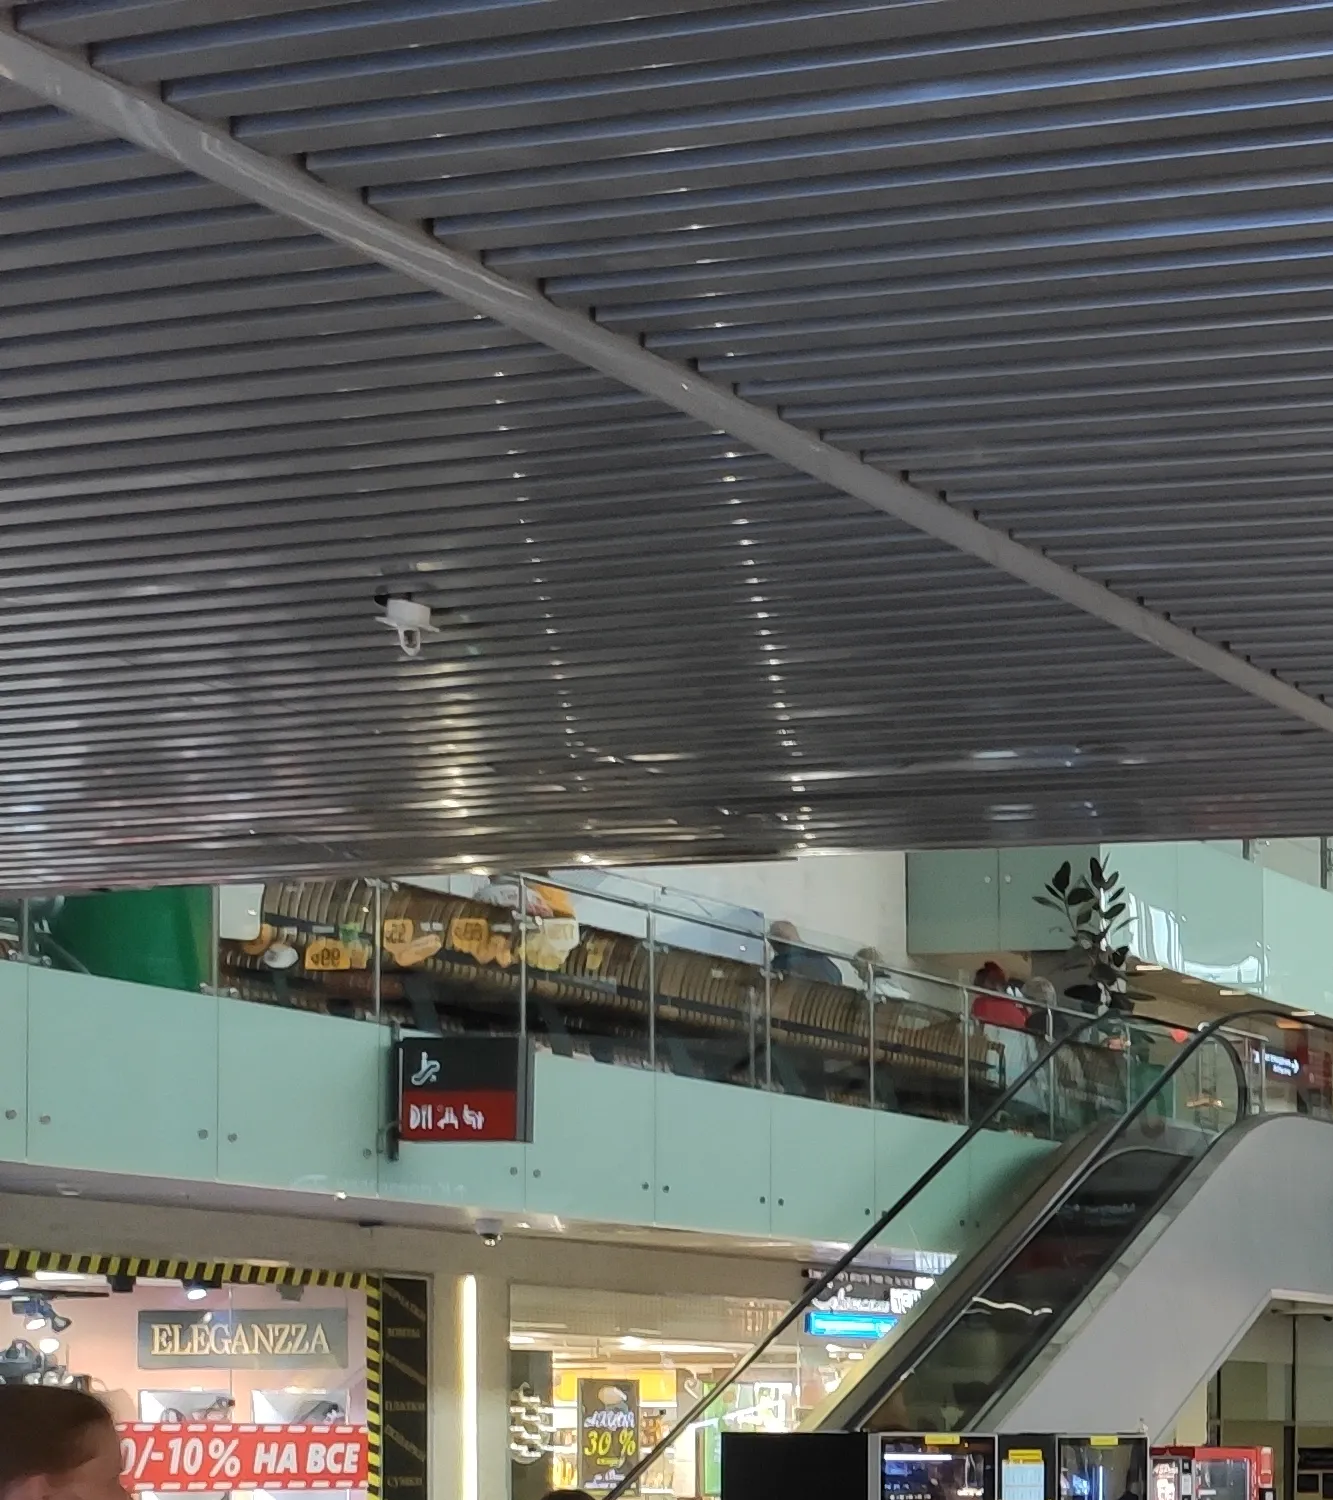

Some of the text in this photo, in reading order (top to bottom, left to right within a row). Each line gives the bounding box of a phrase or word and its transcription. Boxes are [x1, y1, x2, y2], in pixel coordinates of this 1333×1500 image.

[151, 1322, 331, 1356] ELEGANZZA
[253, 1442, 298, 1475] НА
[305, 1442, 361, 1475] ВСЕ
